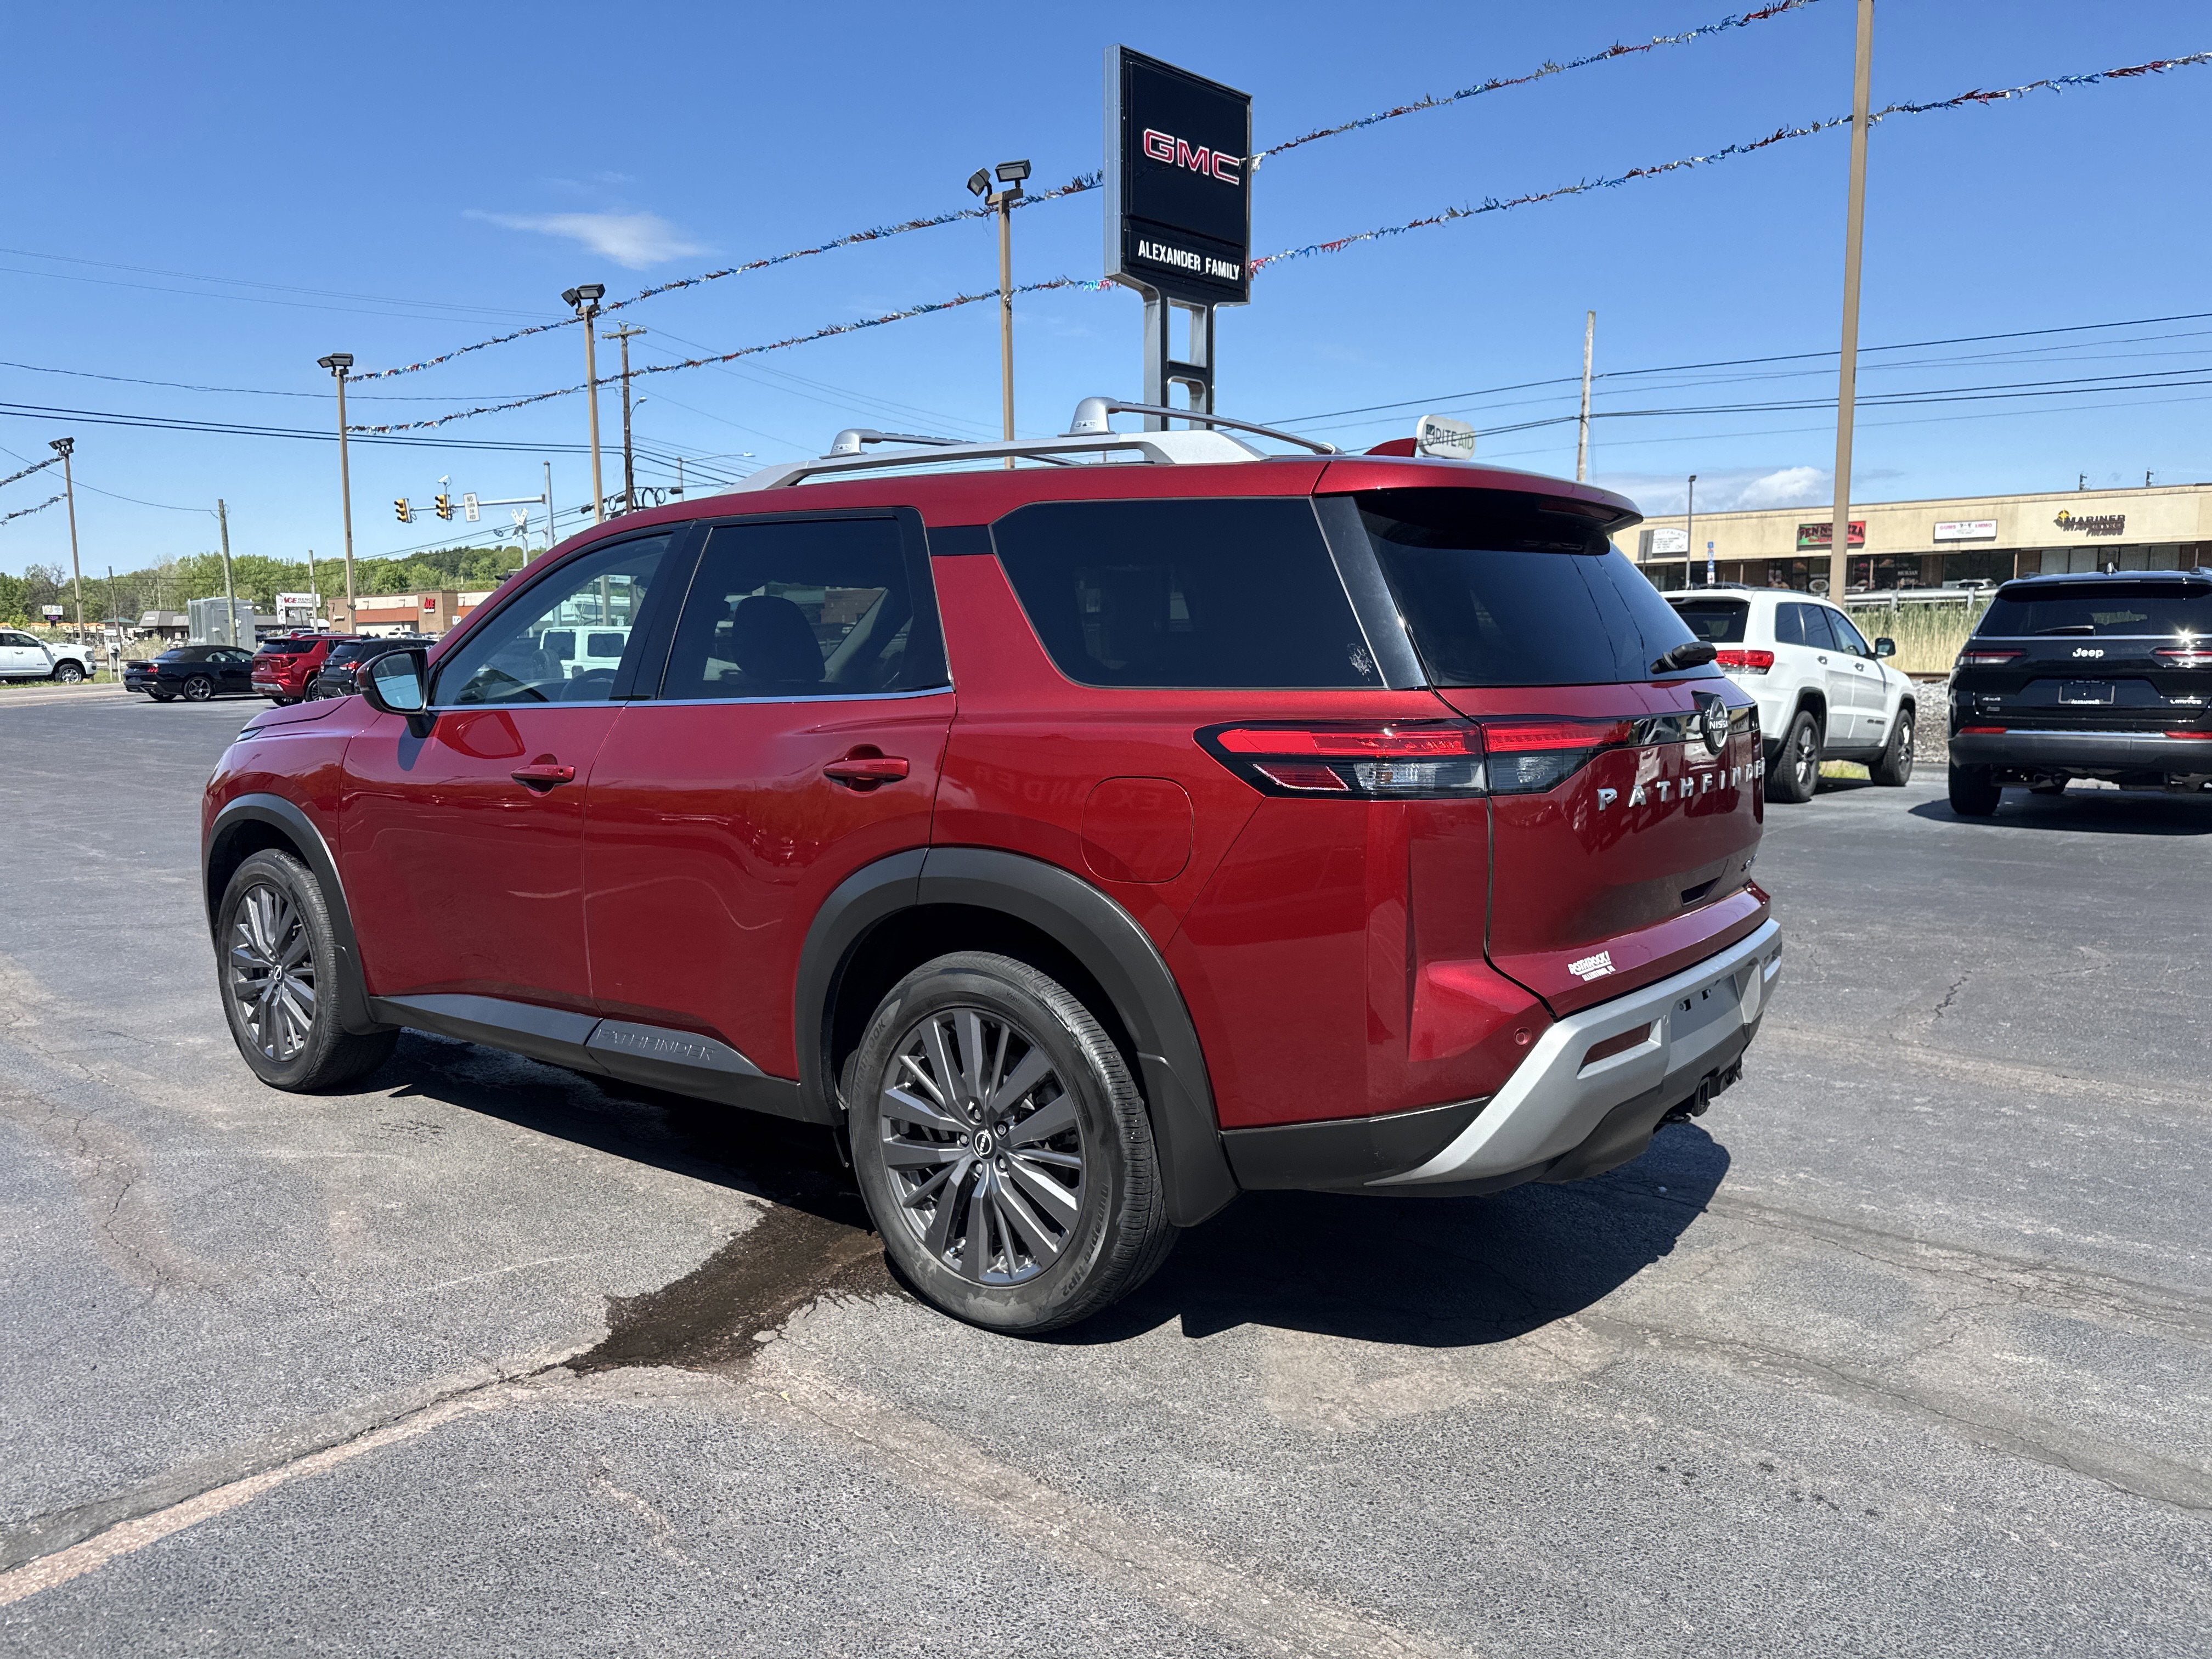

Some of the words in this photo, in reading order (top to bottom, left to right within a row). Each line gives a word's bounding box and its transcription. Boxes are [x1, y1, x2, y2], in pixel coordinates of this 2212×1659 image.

[1143, 128, 1240, 186] GMC
[1138, 239, 1201, 272] ALEXANDER
[1205, 257, 1240, 281] FAMILY
[1436, 428, 1457, 447] RITE
[1458, 433, 1474, 450] AID
[2064, 515, 2125, 524] MARINER
[2072, 647, 2104, 659] Jeep
[596, 1029, 715, 1061] PATHFINDER
[1060, 1266, 1085, 1296] HP2
